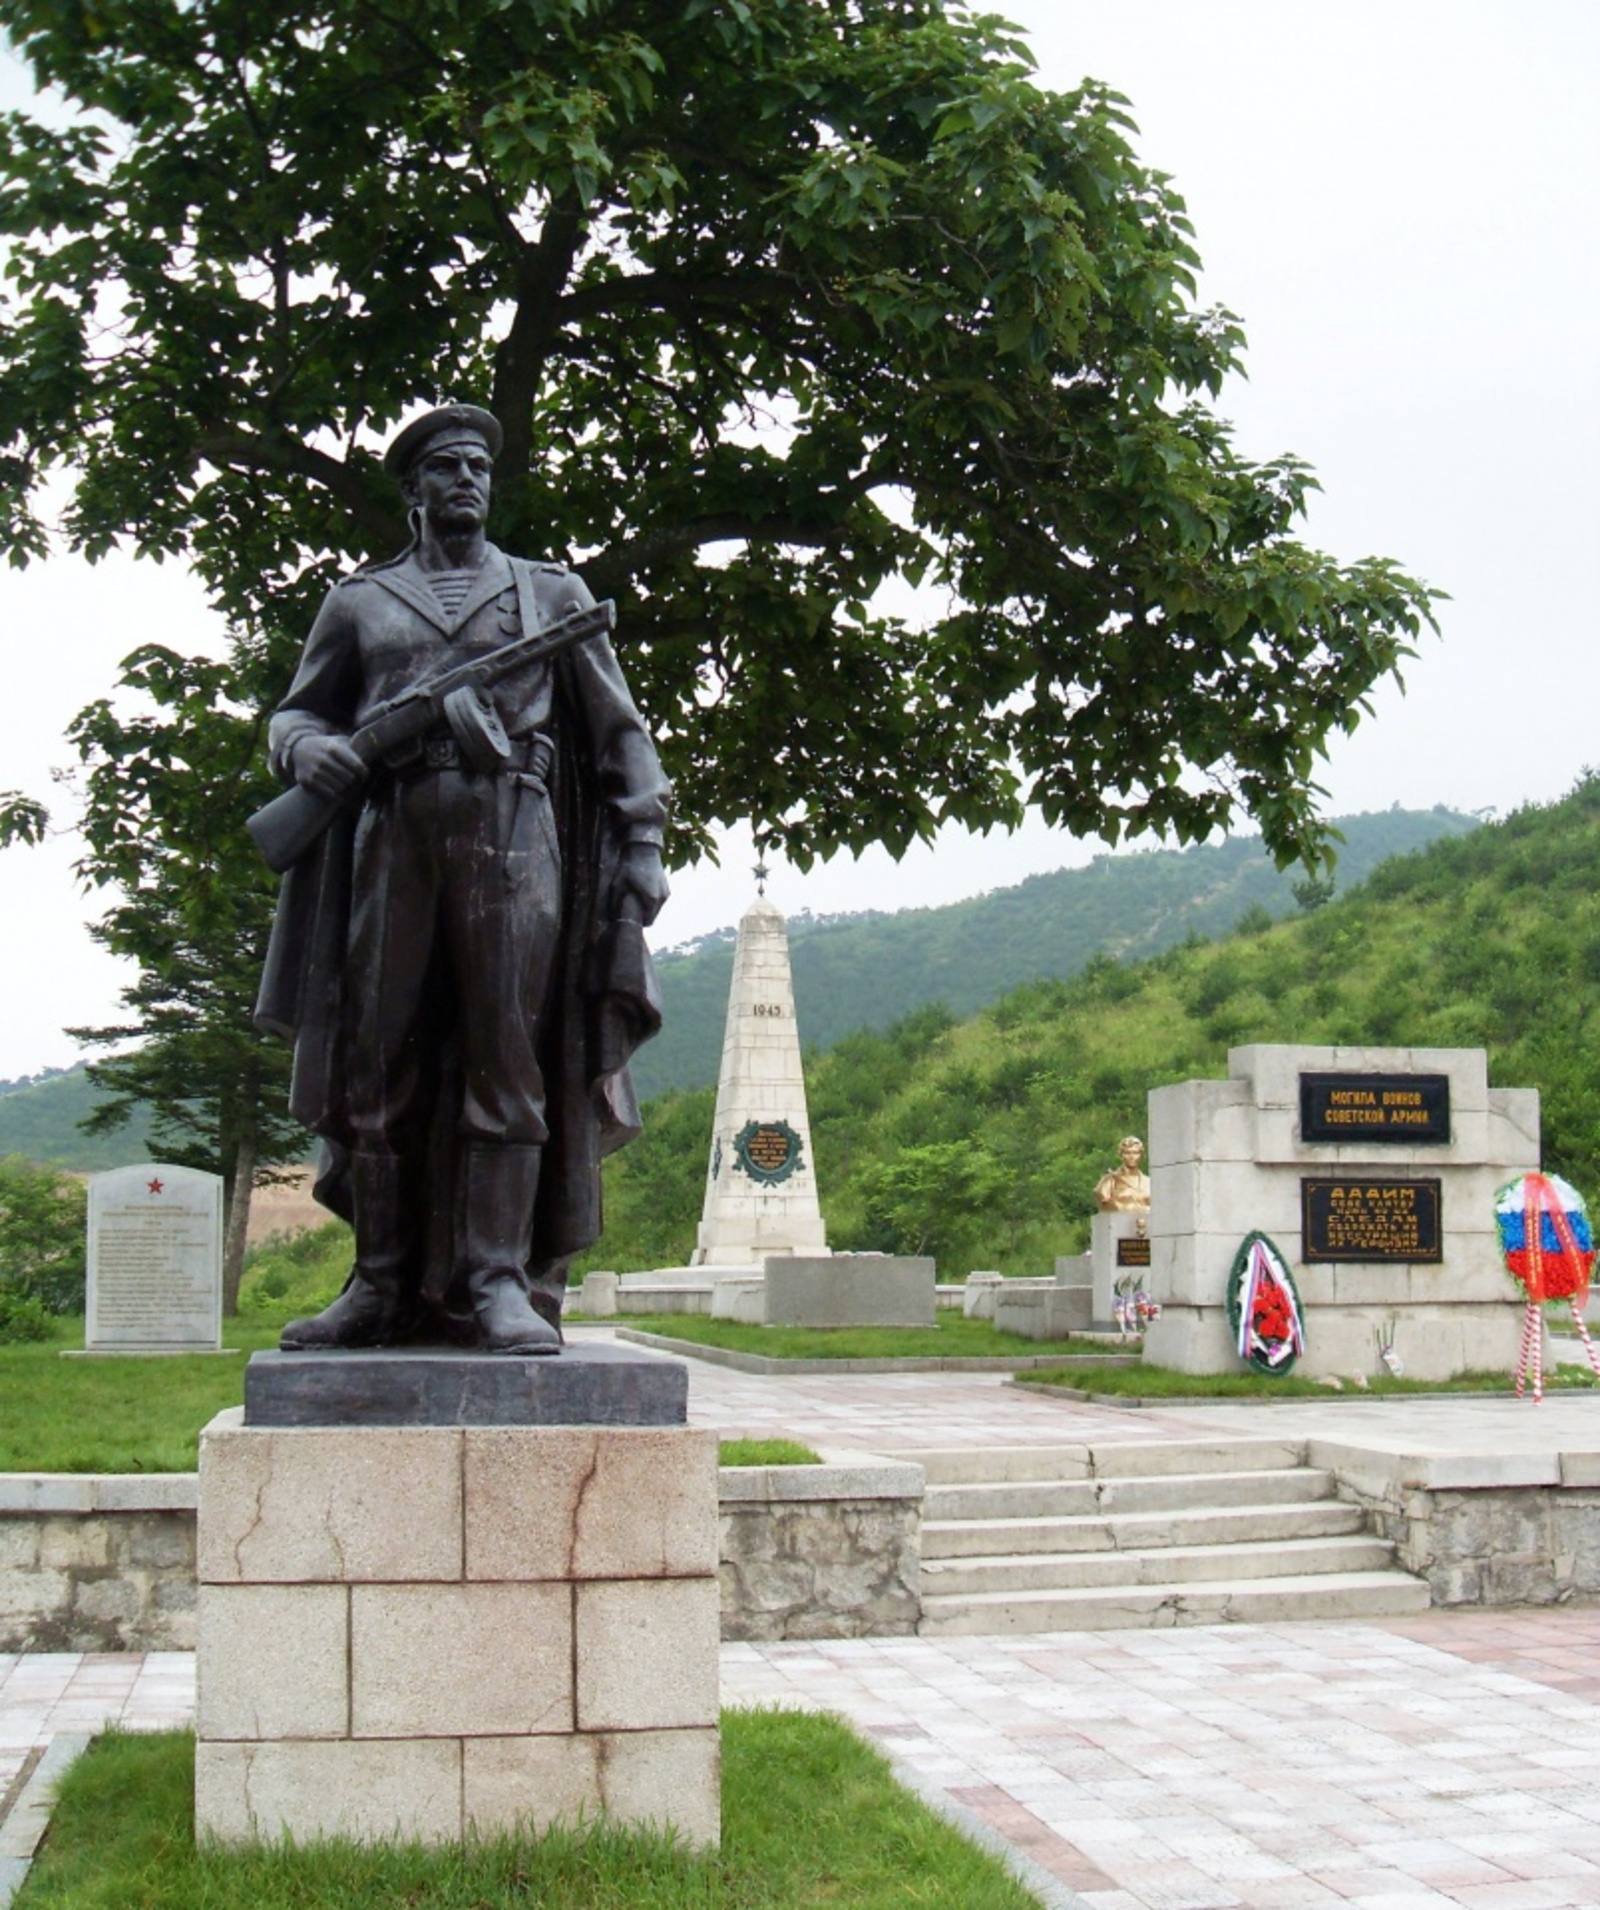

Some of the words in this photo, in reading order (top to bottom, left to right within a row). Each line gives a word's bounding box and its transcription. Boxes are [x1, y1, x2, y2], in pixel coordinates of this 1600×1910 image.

[753, 1003, 782, 1017] 1945
[1330, 1091, 1376, 1105] МОГИЛА
[1382, 1091, 1422, 1105] ВОИНОВ
[1324, 1108, 1385, 1123] СОВЕТСКОЙ
[1390, 1109, 1429, 1124] АРМИИ
